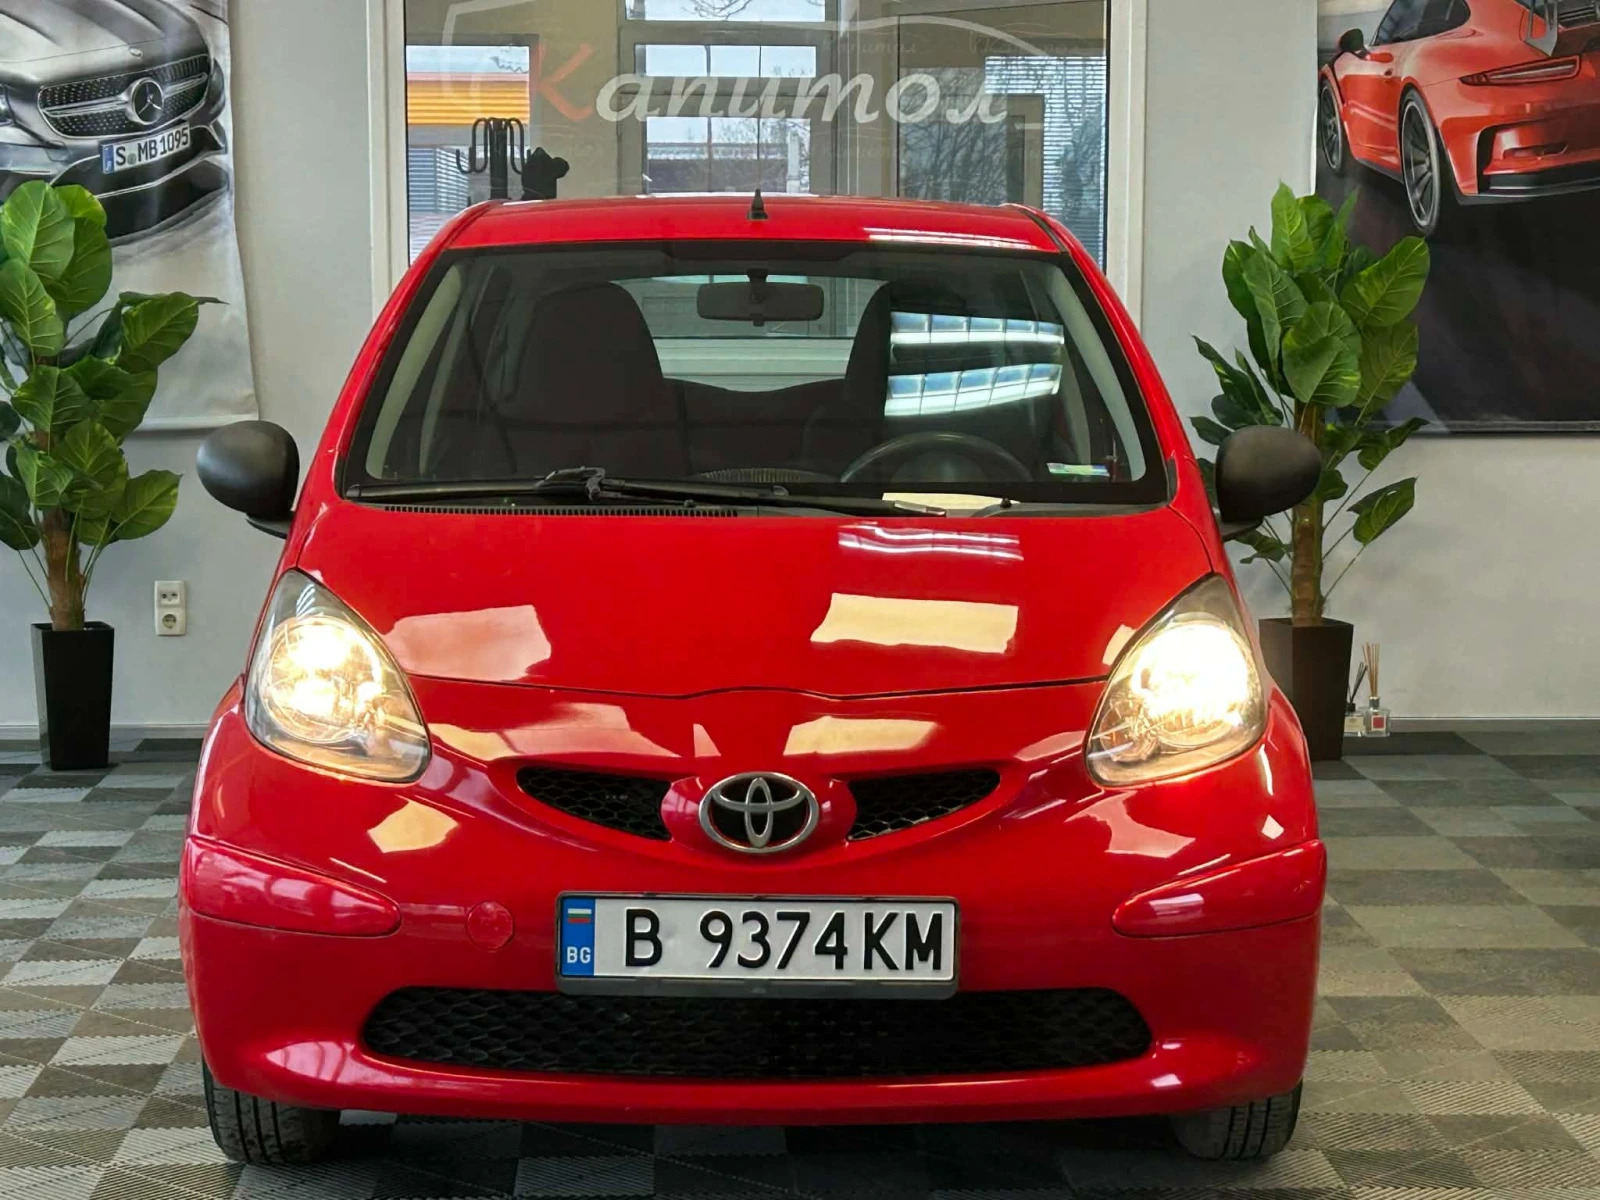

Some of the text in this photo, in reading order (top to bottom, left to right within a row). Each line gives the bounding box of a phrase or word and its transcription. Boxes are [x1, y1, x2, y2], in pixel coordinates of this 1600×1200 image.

[528, 43, 1008, 123] Капитол
[115, 145, 126, 166] S
[566, 946, 591, 964] BG
[625, 908, 663, 967] B
